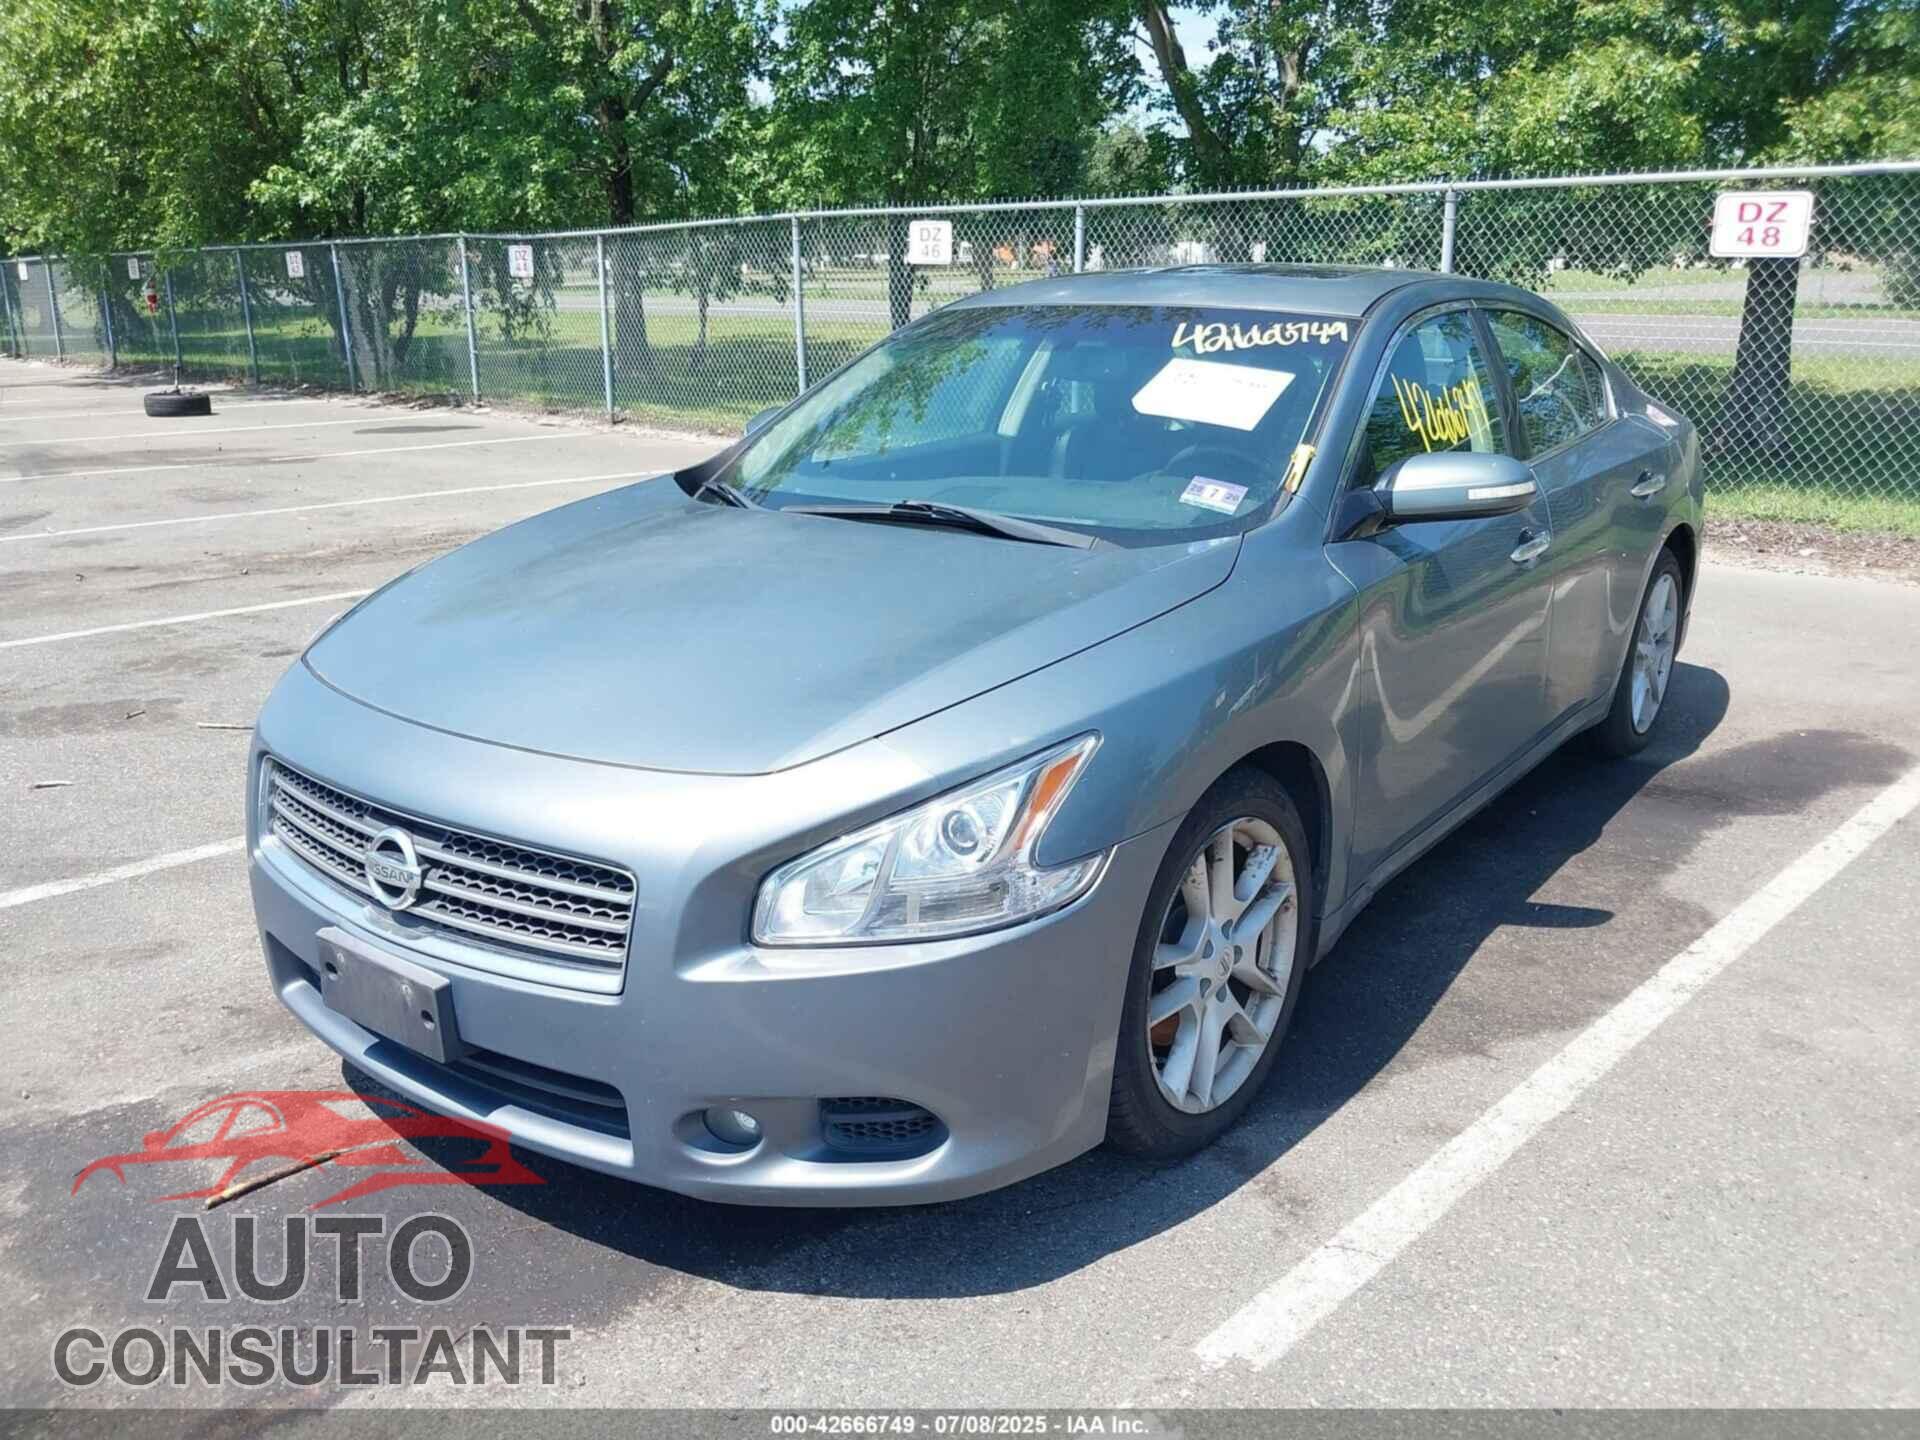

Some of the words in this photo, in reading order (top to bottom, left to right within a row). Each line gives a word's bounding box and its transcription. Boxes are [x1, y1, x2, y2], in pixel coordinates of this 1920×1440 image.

[1737, 201, 1788, 224] DZ
[919, 226, 942, 242] DZ
[1736, 225, 1781, 247] 48
[368, 861, 410, 884] SSAN
